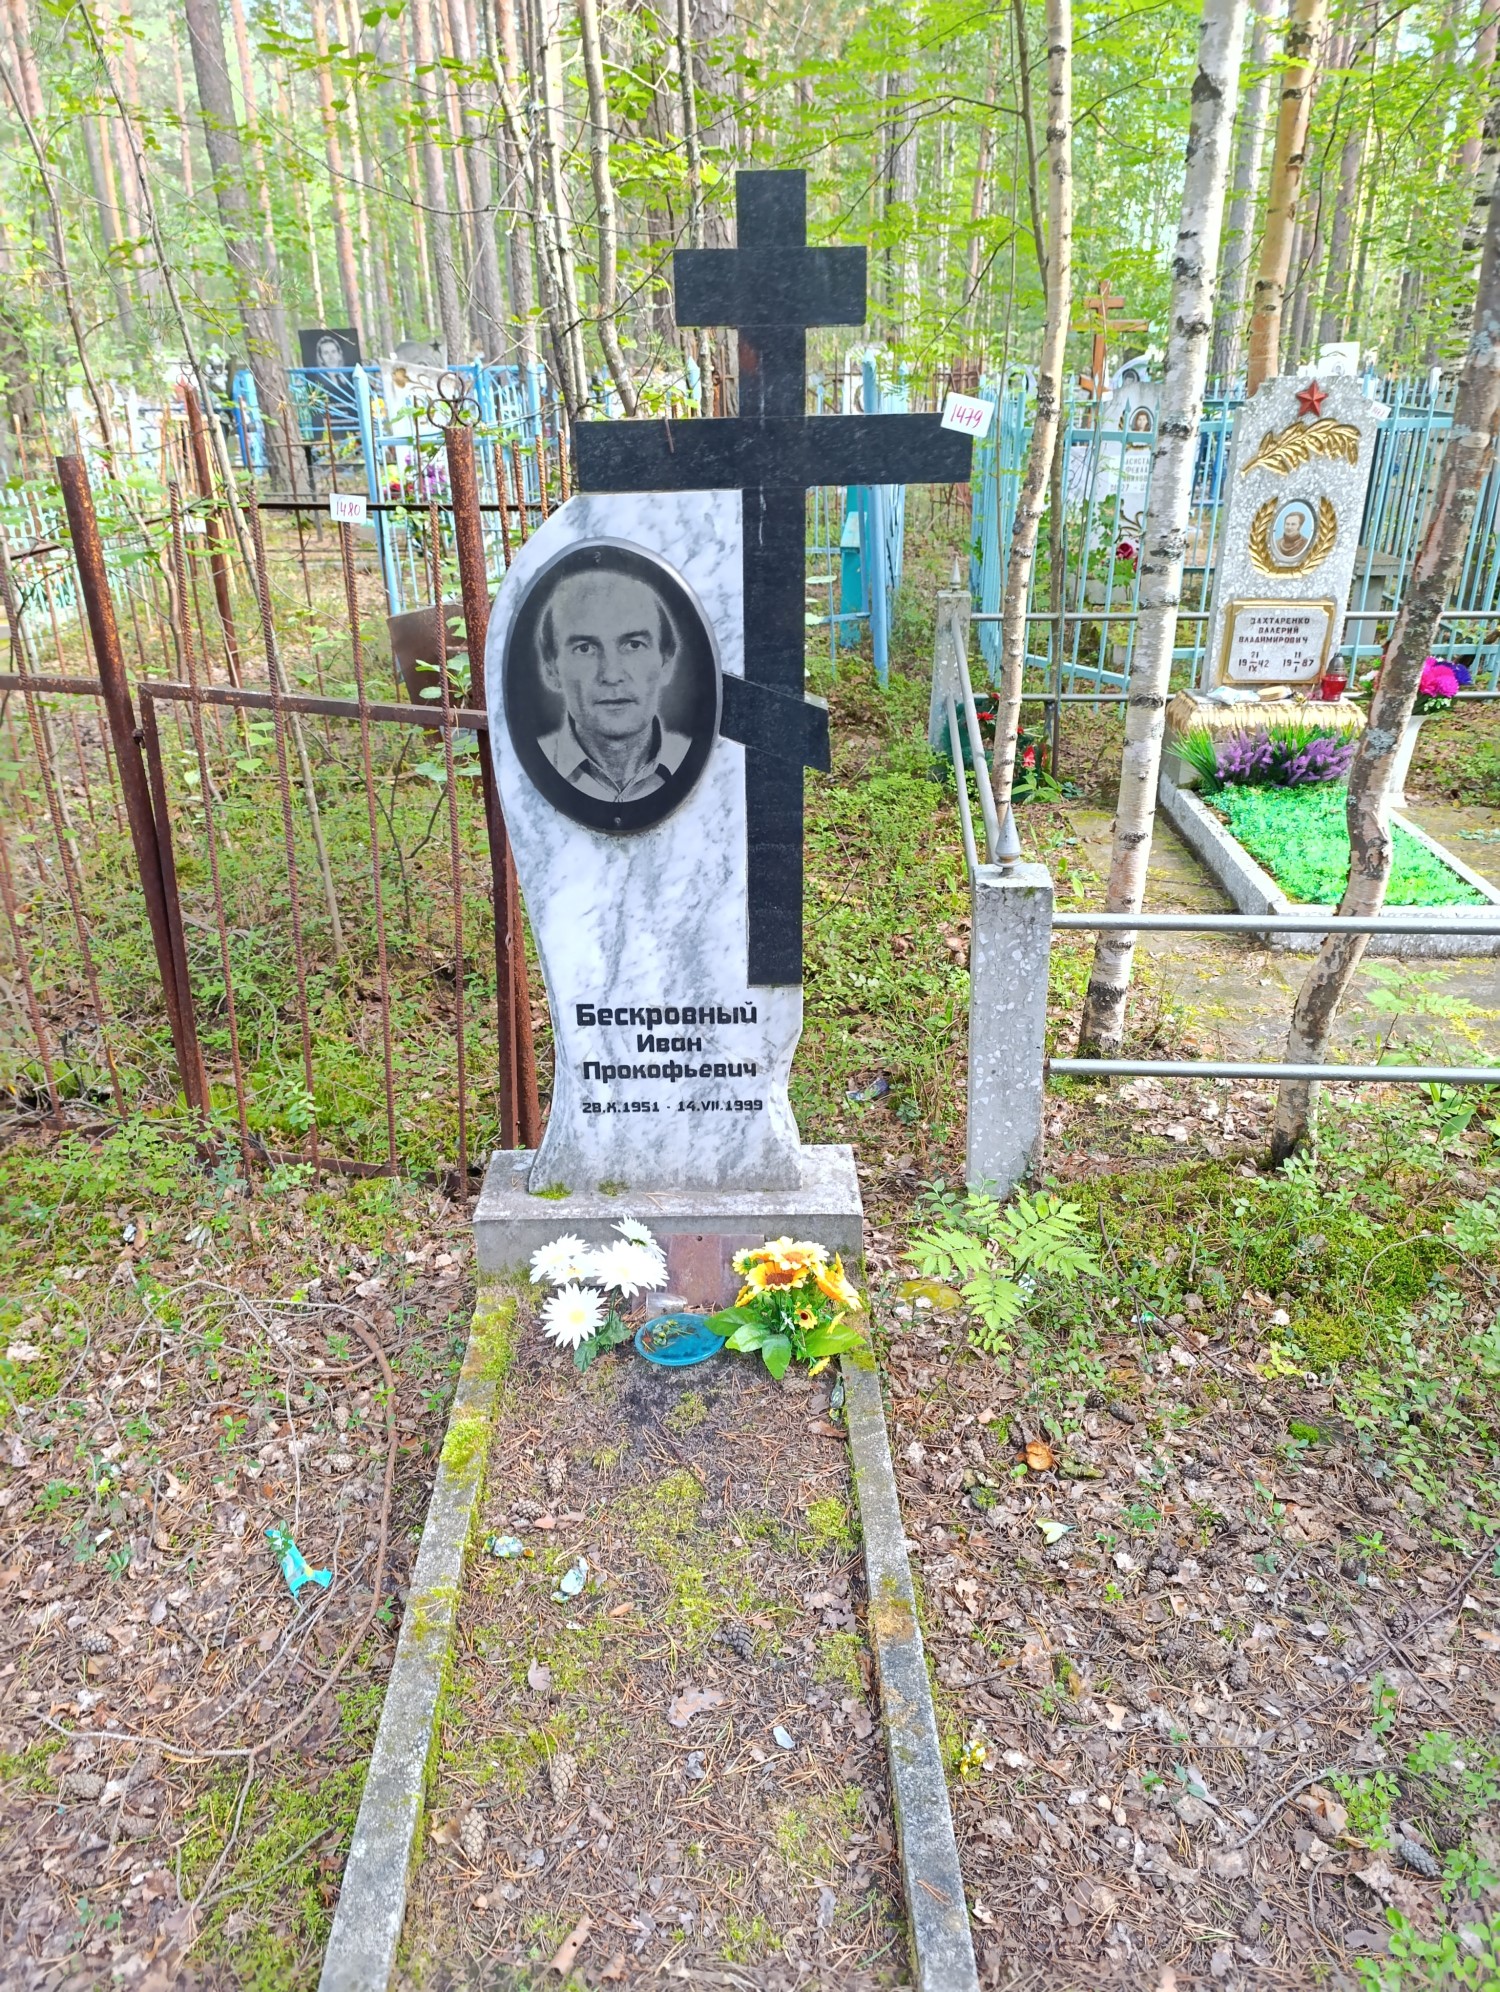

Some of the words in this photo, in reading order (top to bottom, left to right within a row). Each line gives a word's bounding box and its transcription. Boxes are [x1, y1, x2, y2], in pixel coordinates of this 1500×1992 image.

[950, 403, 984, 429] 1479
[336, 501, 361, 517] 1480
[1258, 626, 1299, 634] ВАЛЕРИЙ
[1238, 636, 1309, 644] ВЛАДИМИРОВИЧ
[575, 1001, 758, 1030] Бескровный
[636, 1034, 703, 1053] Иван
[583, 1060, 757, 1083] Прокофьевич
[582, 1101, 660, 1113] 28.X.1951
[677, 1100, 763, 1112] 14.VII.1999
